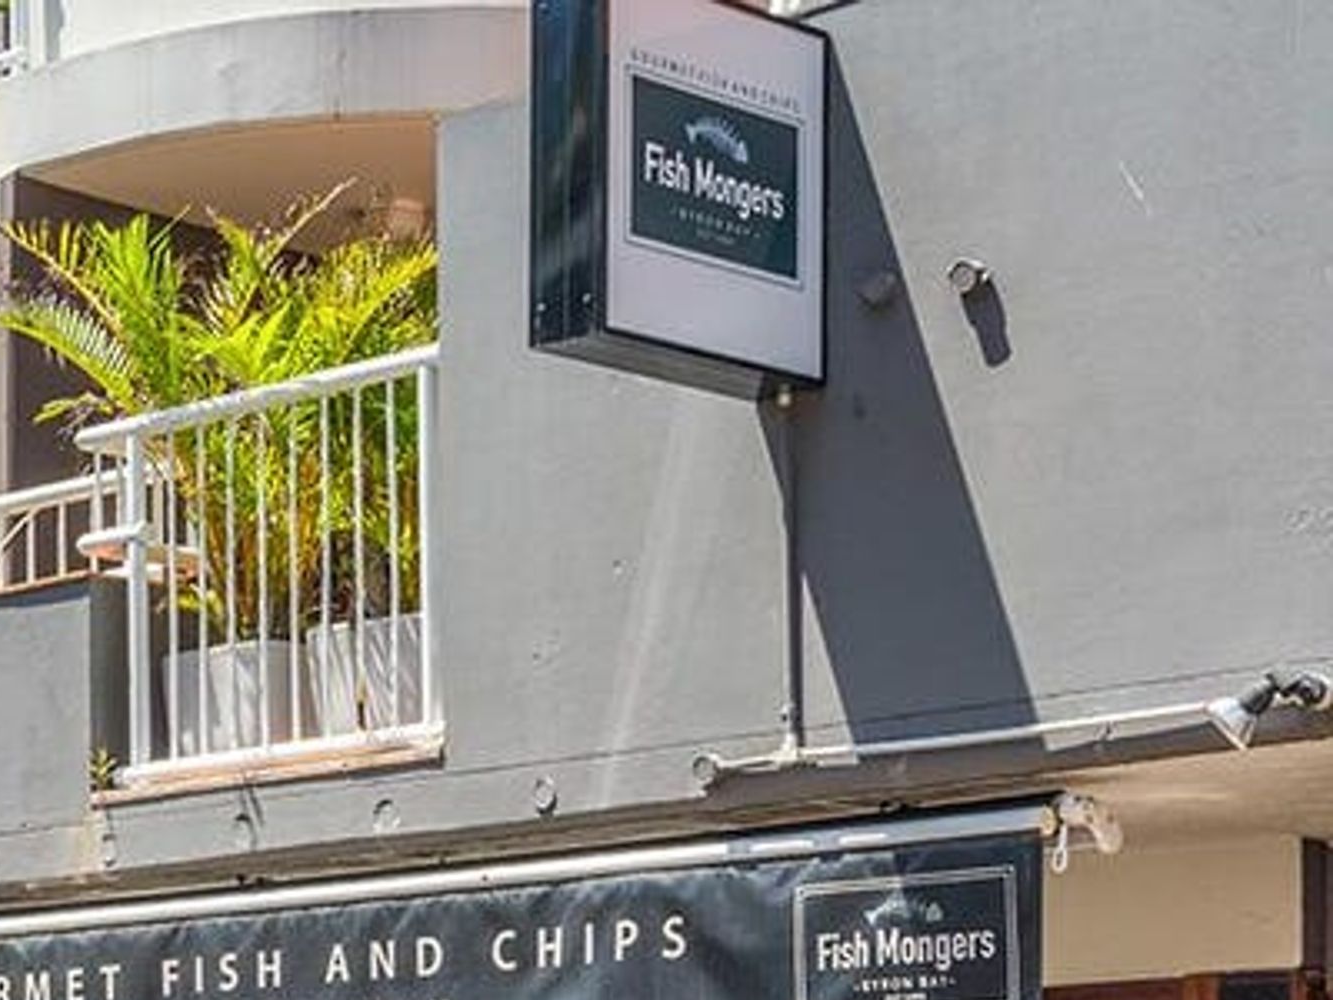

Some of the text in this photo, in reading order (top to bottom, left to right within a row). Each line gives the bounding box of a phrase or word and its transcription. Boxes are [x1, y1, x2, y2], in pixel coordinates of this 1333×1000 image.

[645, 141, 784, 220] Fish Mongers
[161, 949, 282, 997] FISH
[325, 936, 444, 984] AND
[492, 915, 687, 971] CHIPS
[817, 927, 997, 971] Fish Mongers
